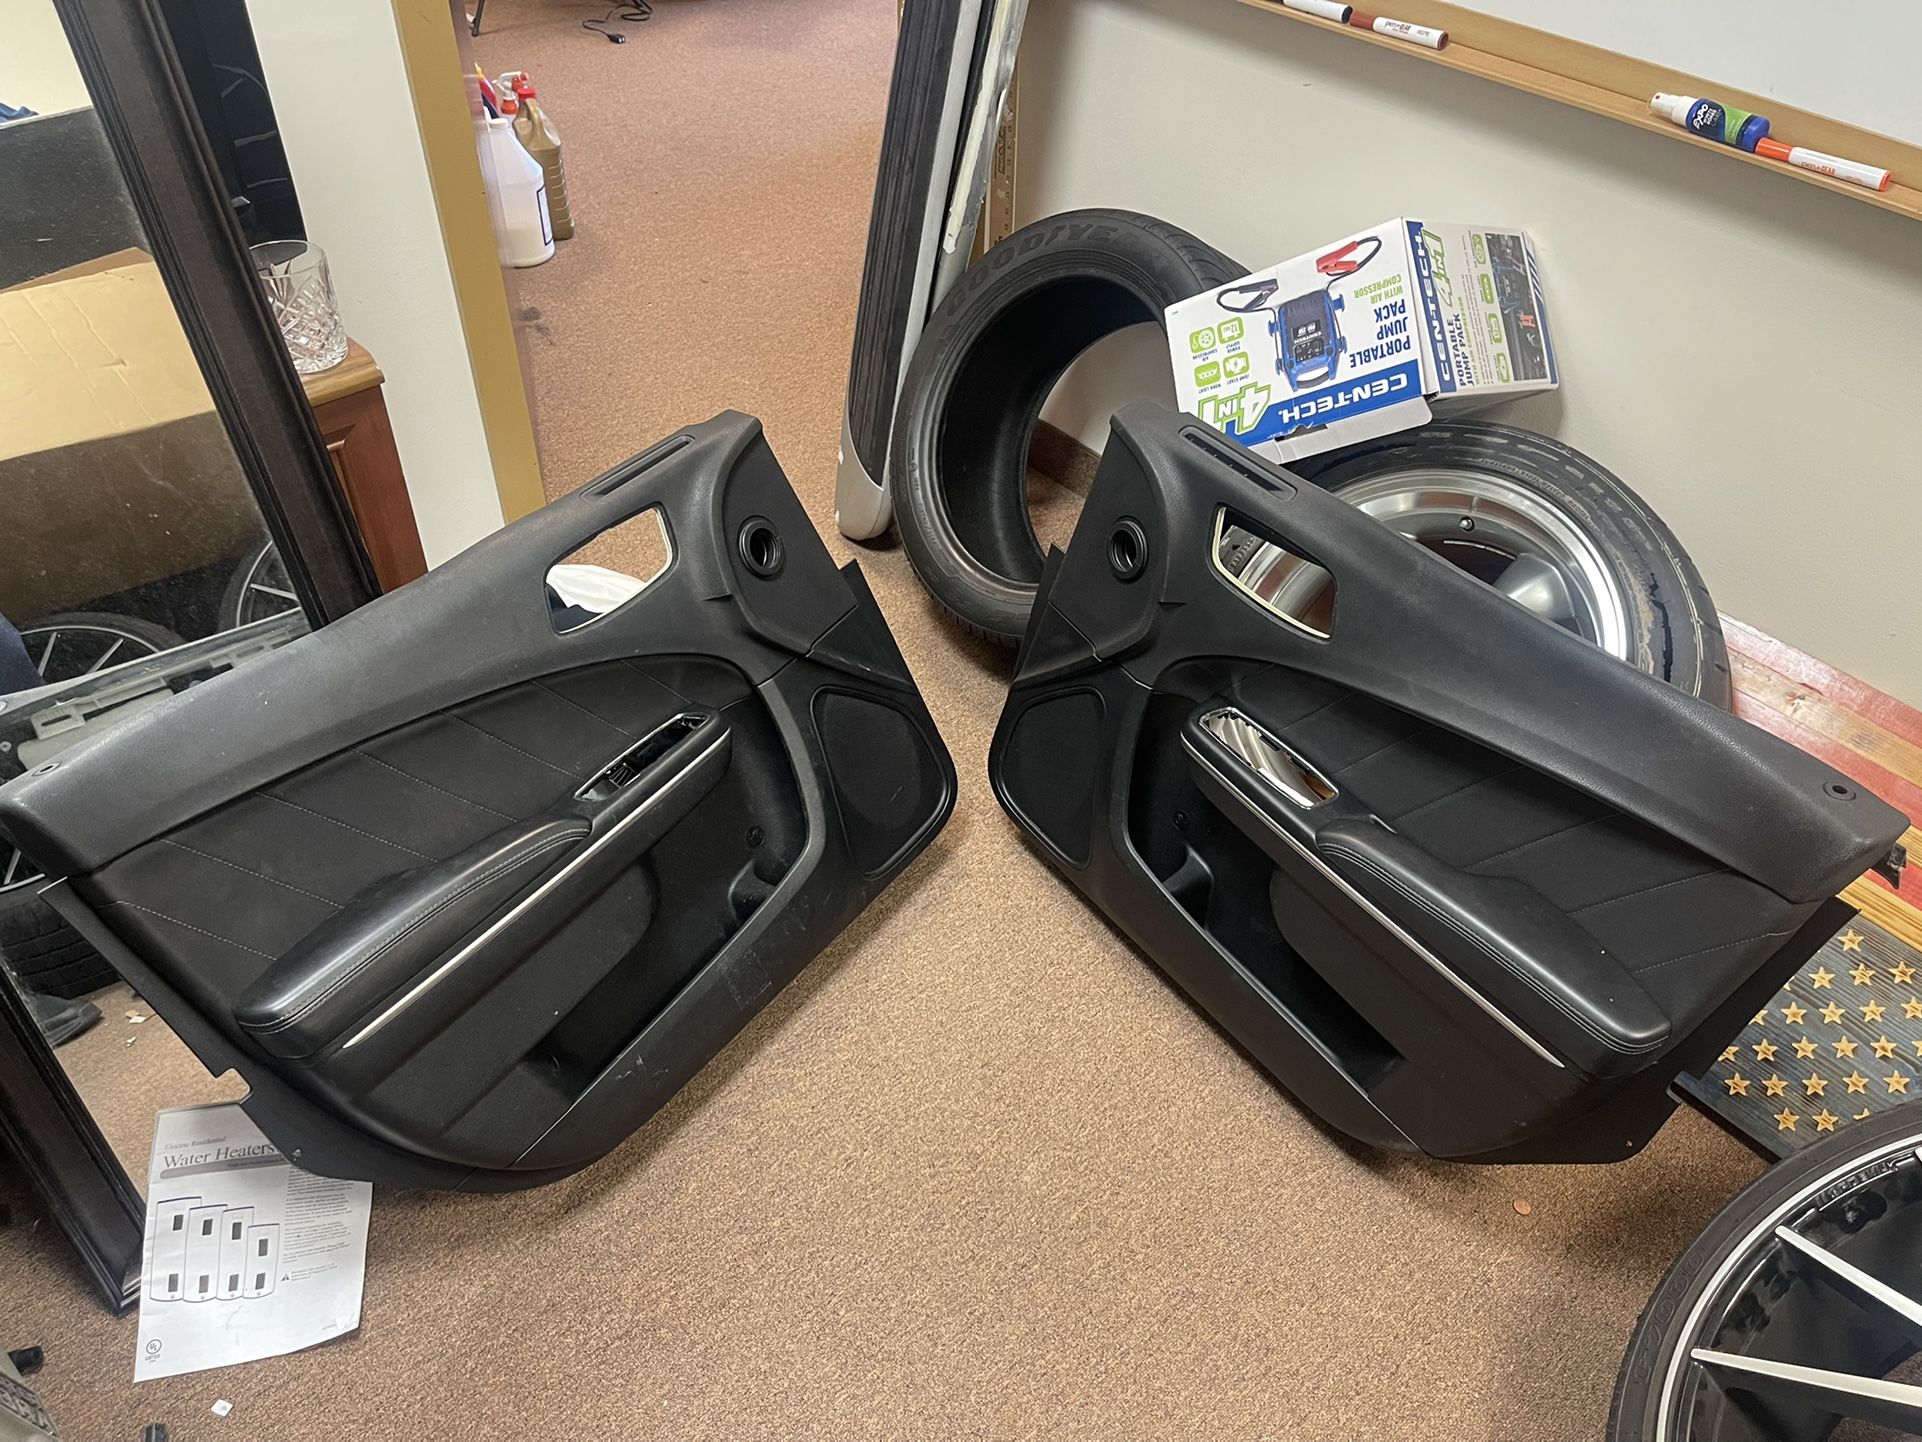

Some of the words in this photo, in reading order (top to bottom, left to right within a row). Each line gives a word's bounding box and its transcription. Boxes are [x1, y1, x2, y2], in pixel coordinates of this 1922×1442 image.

[1693, 104, 1709, 130] EXPO
[1353, 274, 1402, 299] COMPRESSOR
[1370, 292, 1384, 304] AIR
[1387, 285, 1404, 299] WITH
[1374, 299, 1406, 323] PACK
[1376, 316, 1408, 341] JUMP
[1454, 313, 1465, 347] PACK
[1350, 335, 1412, 368] PORTABLE
[1447, 319, 1466, 387] PORTABLE
[1461, 351, 1474, 387] JUMP
[163, 1152, 211, 1169] Water
[215, 1143, 277, 1161] Heaters
